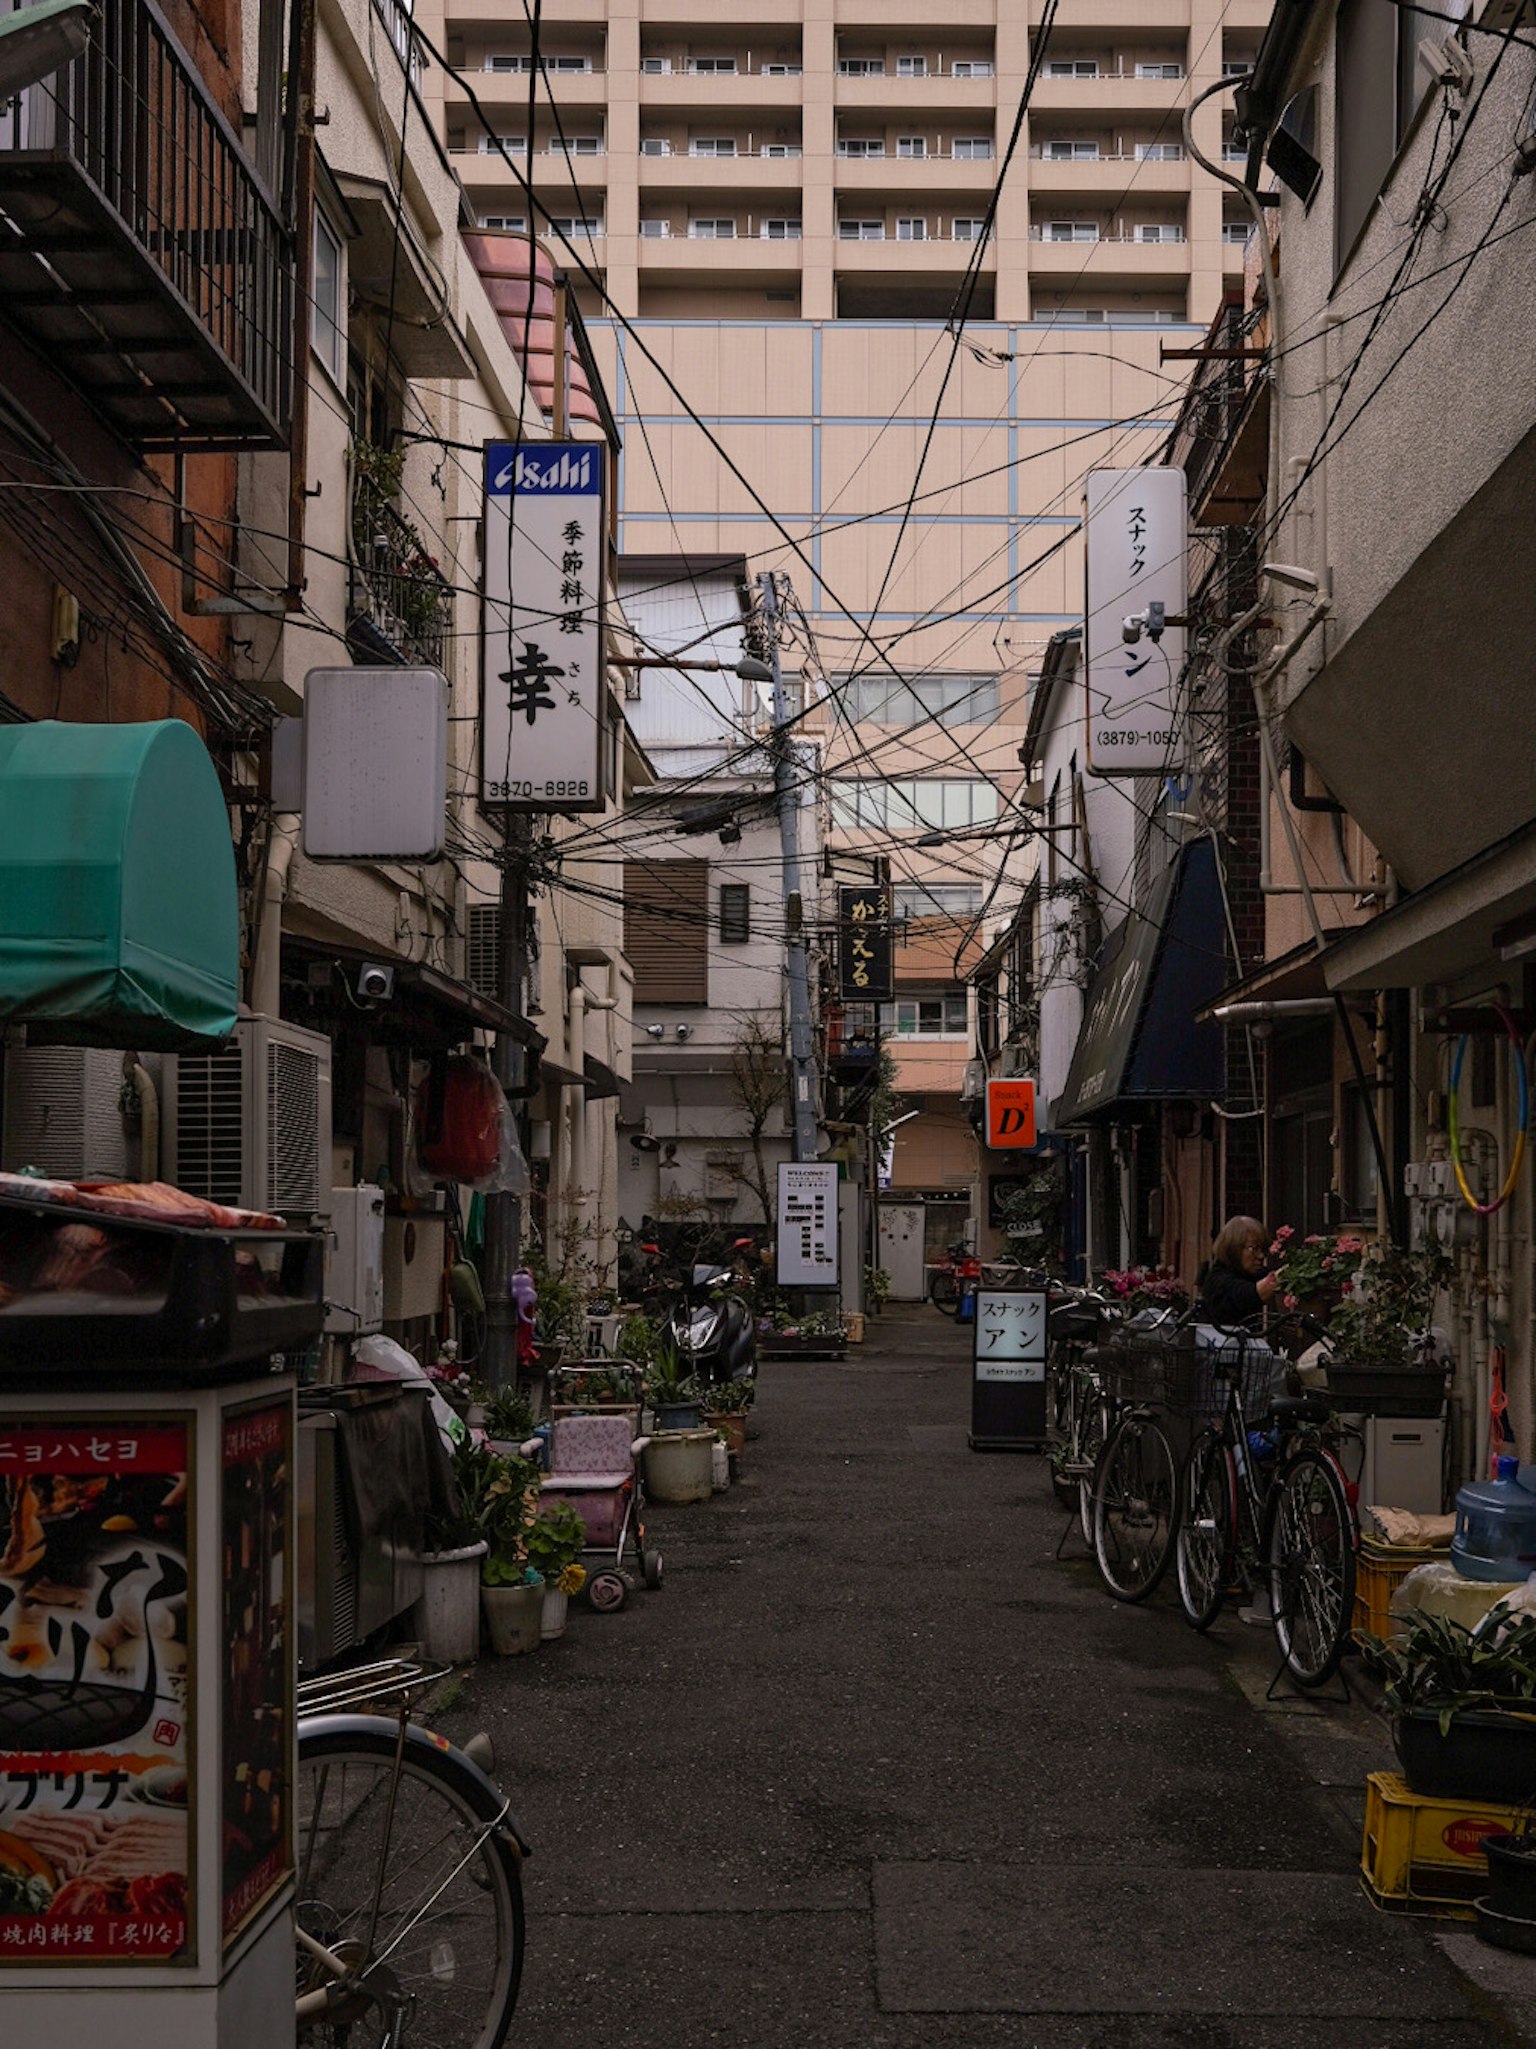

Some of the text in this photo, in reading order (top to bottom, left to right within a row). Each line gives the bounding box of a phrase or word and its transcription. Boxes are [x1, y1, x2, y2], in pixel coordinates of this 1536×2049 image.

[495, 451, 591, 490] Asahi
[1126, 506, 1147, 579] スナック
[560, 520, 585, 636] 季節料理
[499, 642, 565, 726] 幸
[566, 660, 582, 707] さち
[982, 1301, 1040, 1318] スナック
[985, 1328, 1039, 1350] アン
[0, 1769, 129, 1811] ブリナ
